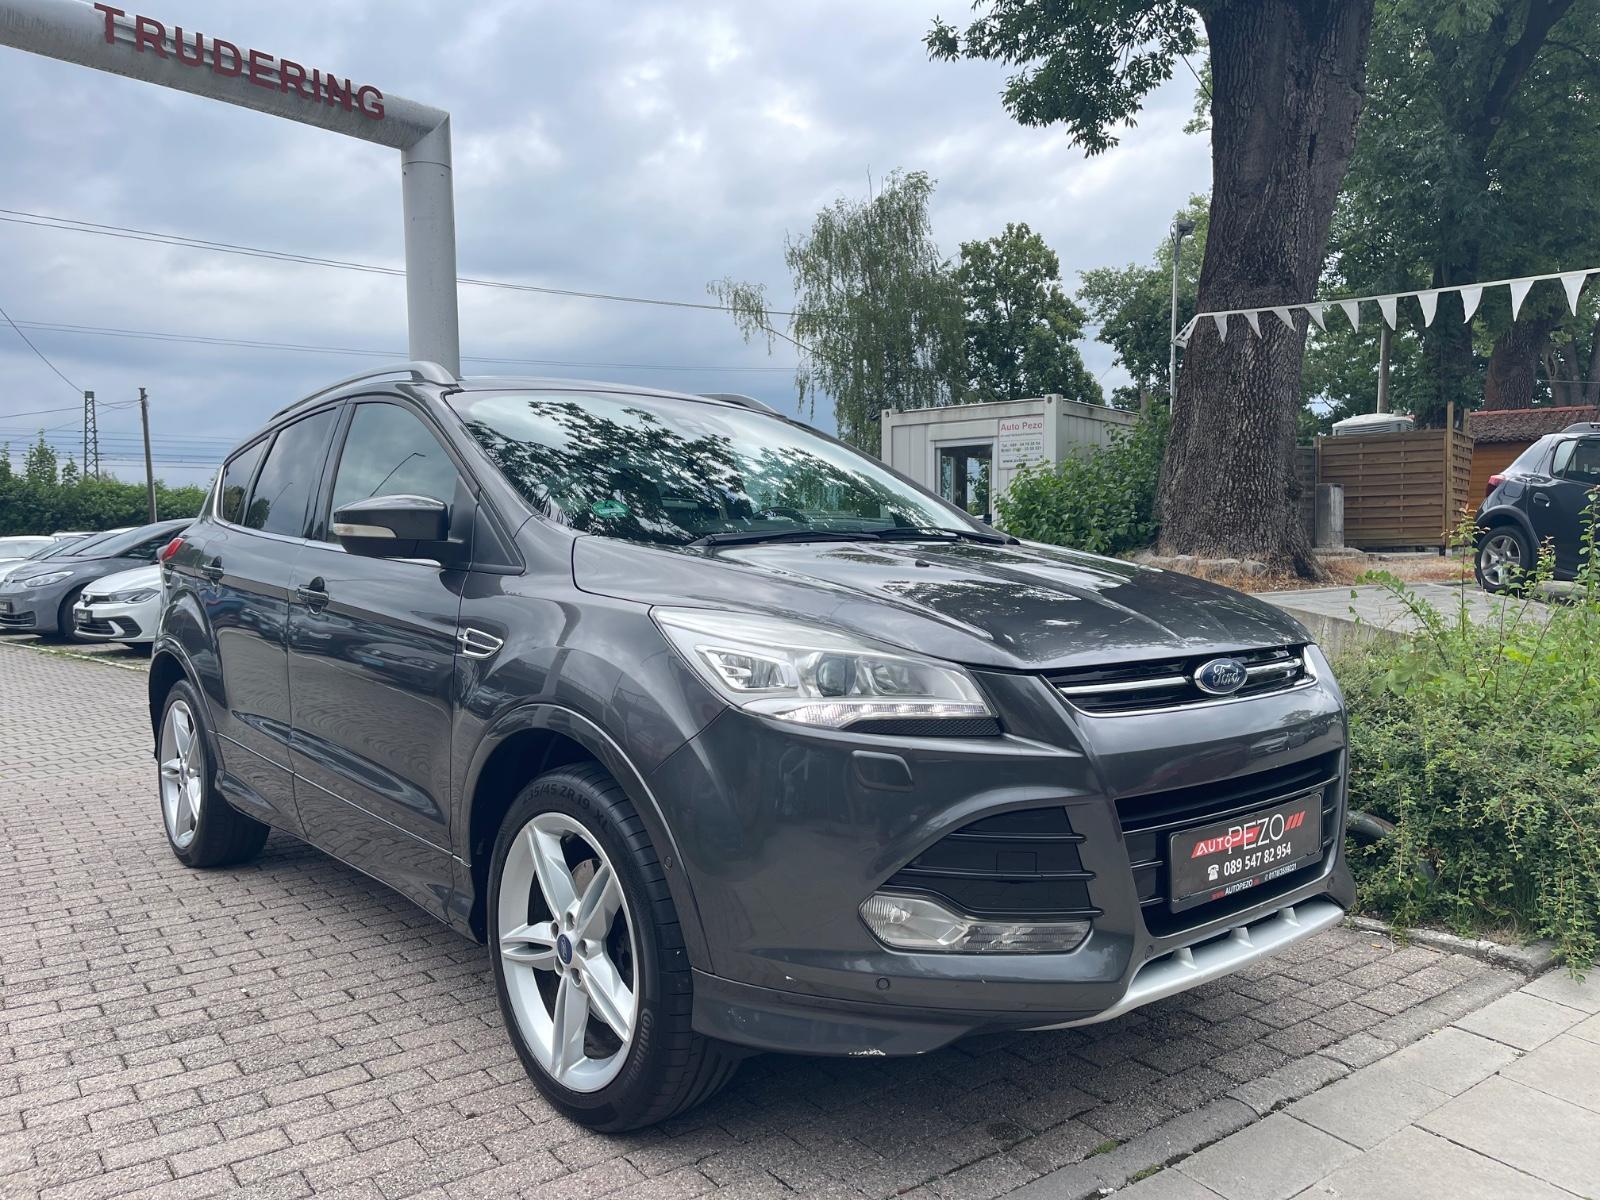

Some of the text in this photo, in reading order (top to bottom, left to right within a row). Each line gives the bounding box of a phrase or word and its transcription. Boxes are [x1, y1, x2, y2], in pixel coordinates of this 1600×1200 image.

[94, 2, 384, 120] TRUDERING
[1001, 421, 1042, 431] Auto Pezo
[1212, 664, 1240, 687] Ford
[1224, 842, 1291, 876] 089 547 82 954
